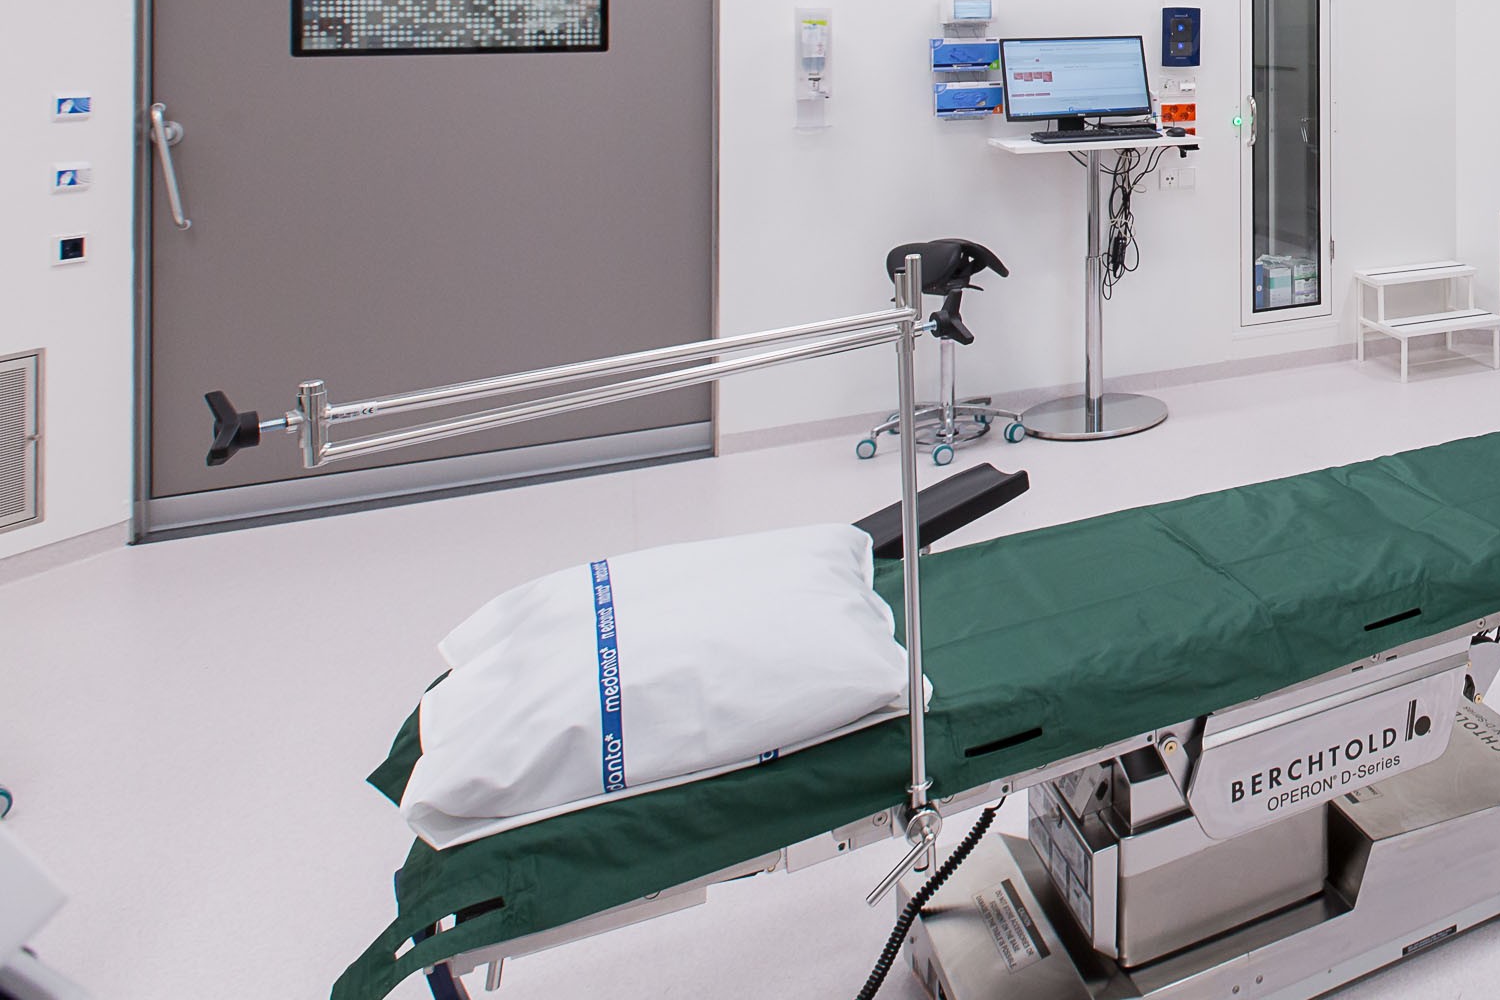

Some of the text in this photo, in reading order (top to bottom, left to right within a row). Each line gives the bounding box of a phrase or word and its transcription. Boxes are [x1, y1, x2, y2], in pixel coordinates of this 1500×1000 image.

[1231, 727, 1398, 804] BERCHTOLD
[1341, 755, 1401, 785] D-Series
[1009, 917, 1030, 949] ACCESSORIES
